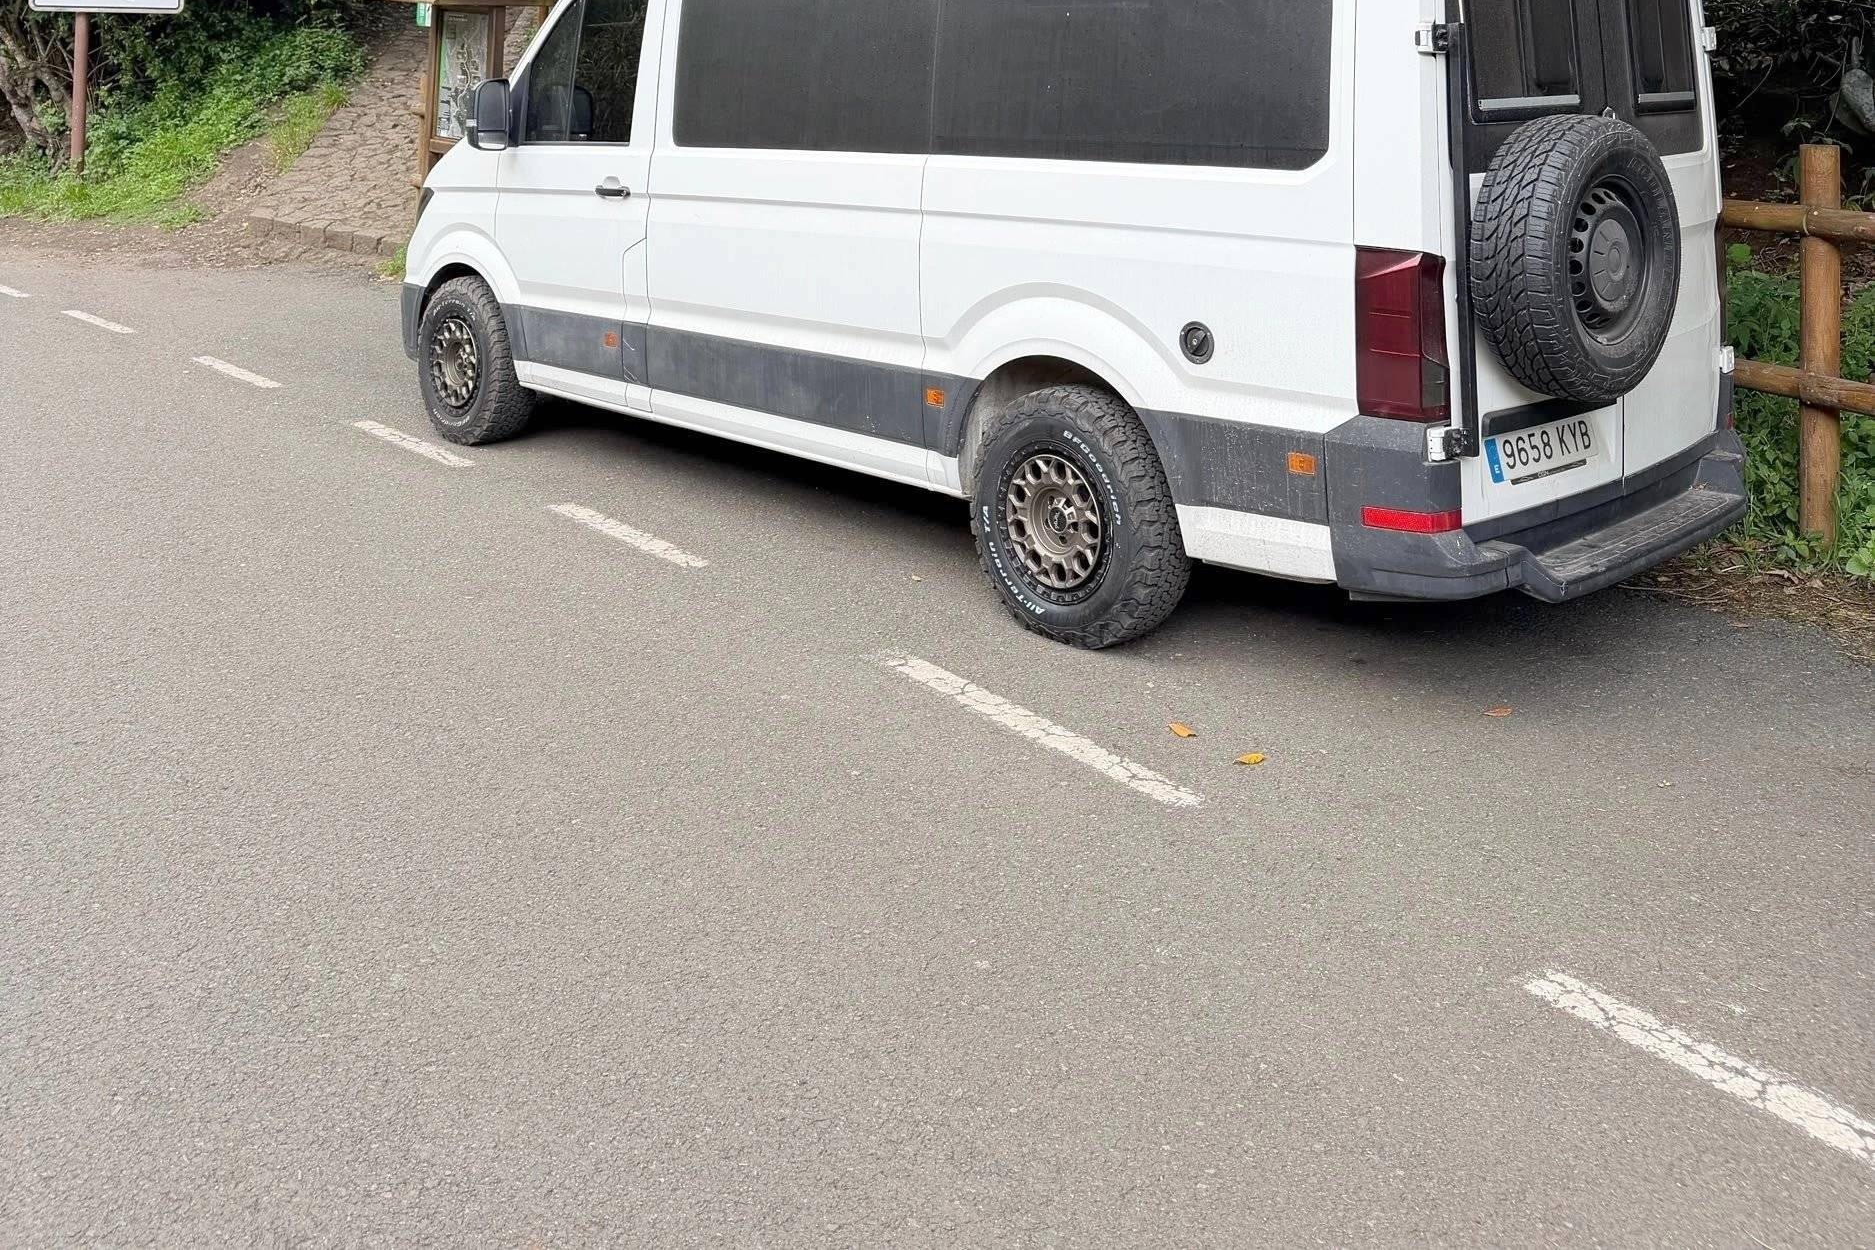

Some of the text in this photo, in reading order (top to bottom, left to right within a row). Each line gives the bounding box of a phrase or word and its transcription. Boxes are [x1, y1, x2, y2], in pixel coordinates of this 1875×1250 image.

[1063, 430, 1122, 525] BFGoodrich
[1502, 420, 1591, 470] 9658 KYB
[988, 541, 1046, 615] All-Terrain
